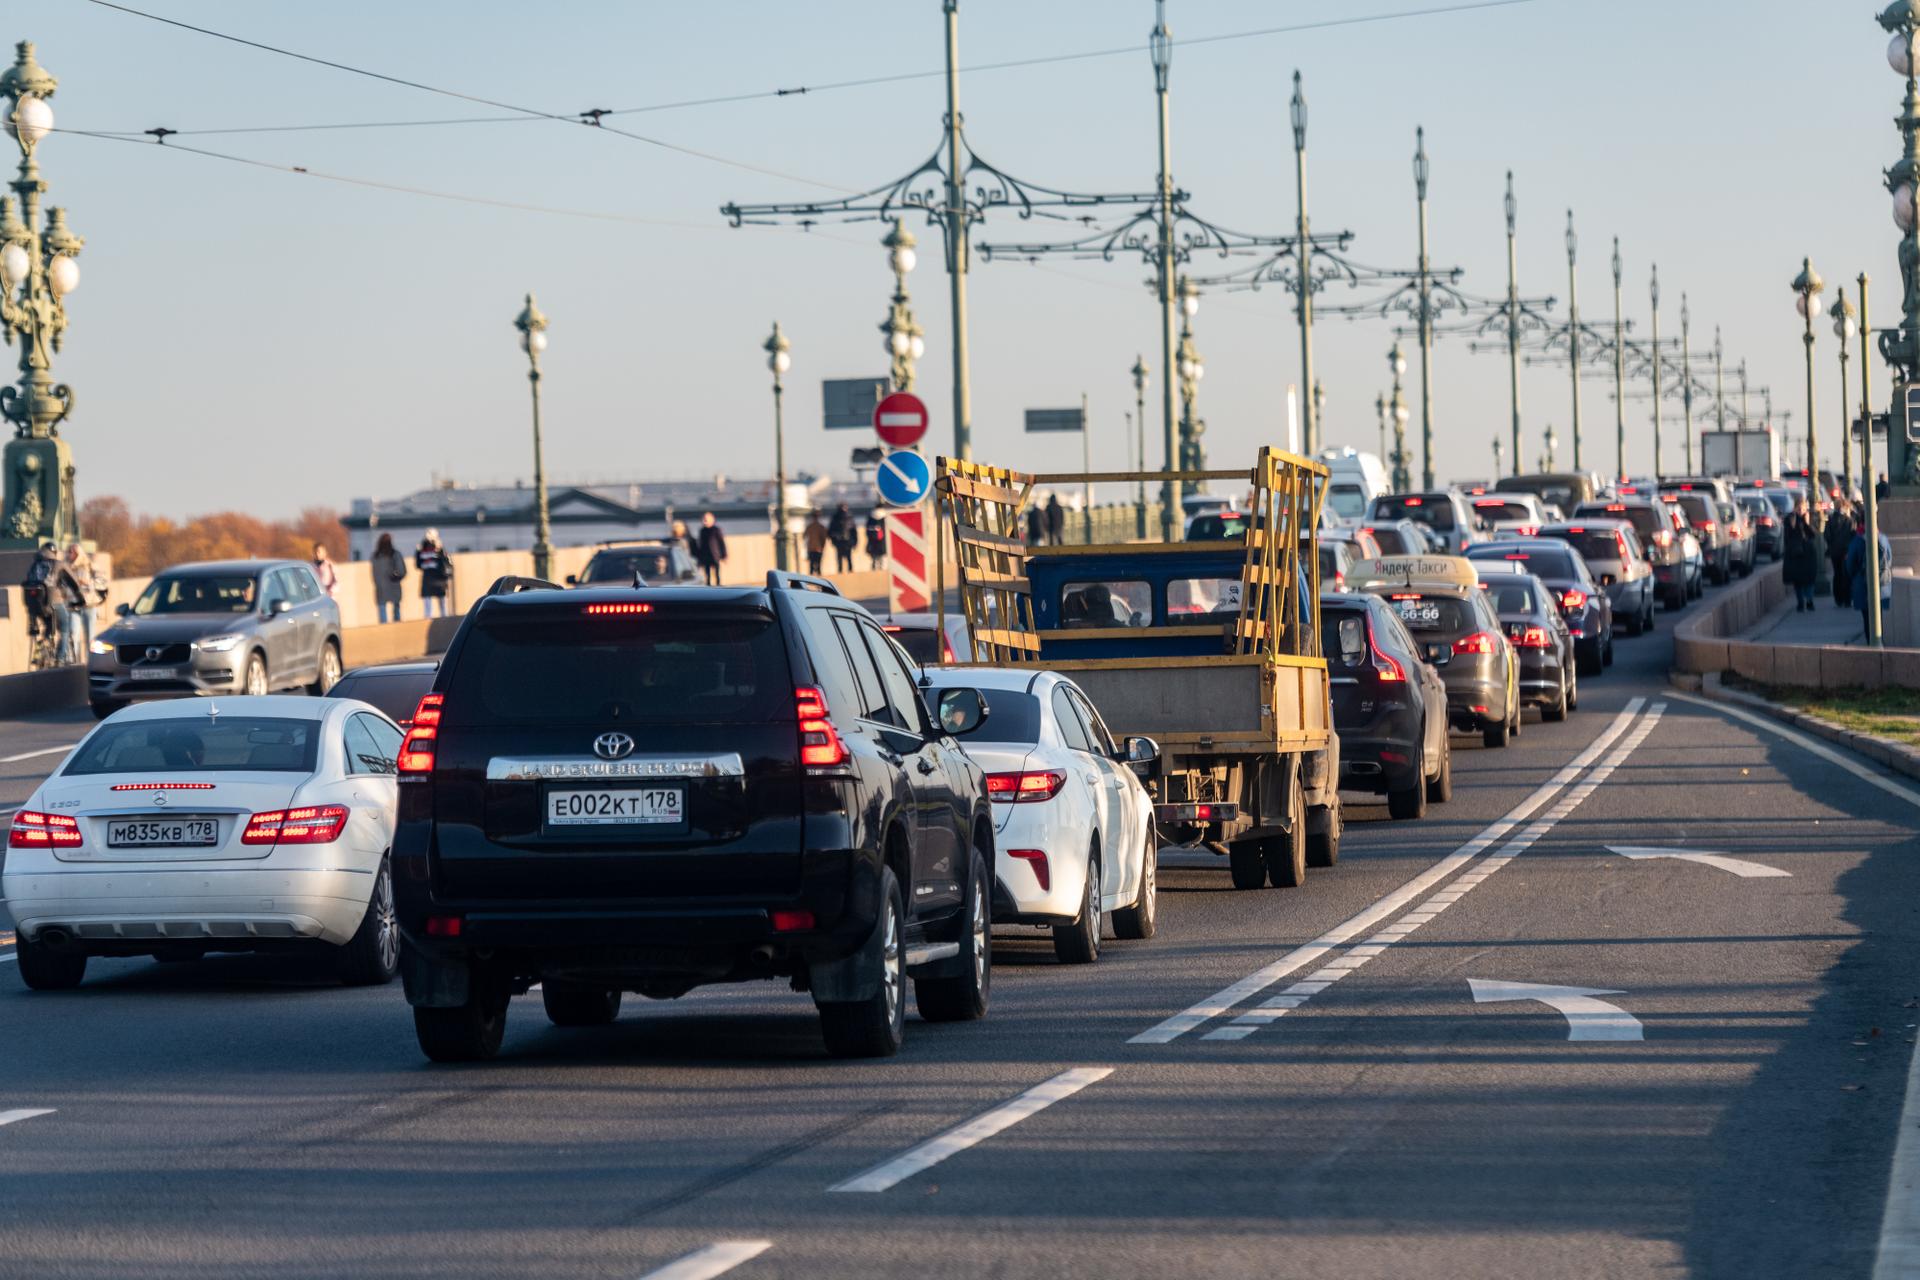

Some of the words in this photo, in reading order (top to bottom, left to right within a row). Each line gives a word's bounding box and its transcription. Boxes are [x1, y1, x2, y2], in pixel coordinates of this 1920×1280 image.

[1375, 560, 1414, 576] Яндекс
[1417, 560, 1448, 575] Такси
[521, 764, 566, 776] LAND
[569, 763, 642, 775] CRUISER
[648, 761, 705, 774] PRADO
[555, 793, 640, 816] Е002КТ
[645, 791, 677, 808] 178
[114, 823, 182, 842] М835КВ
[186, 822, 212, 836] 178
